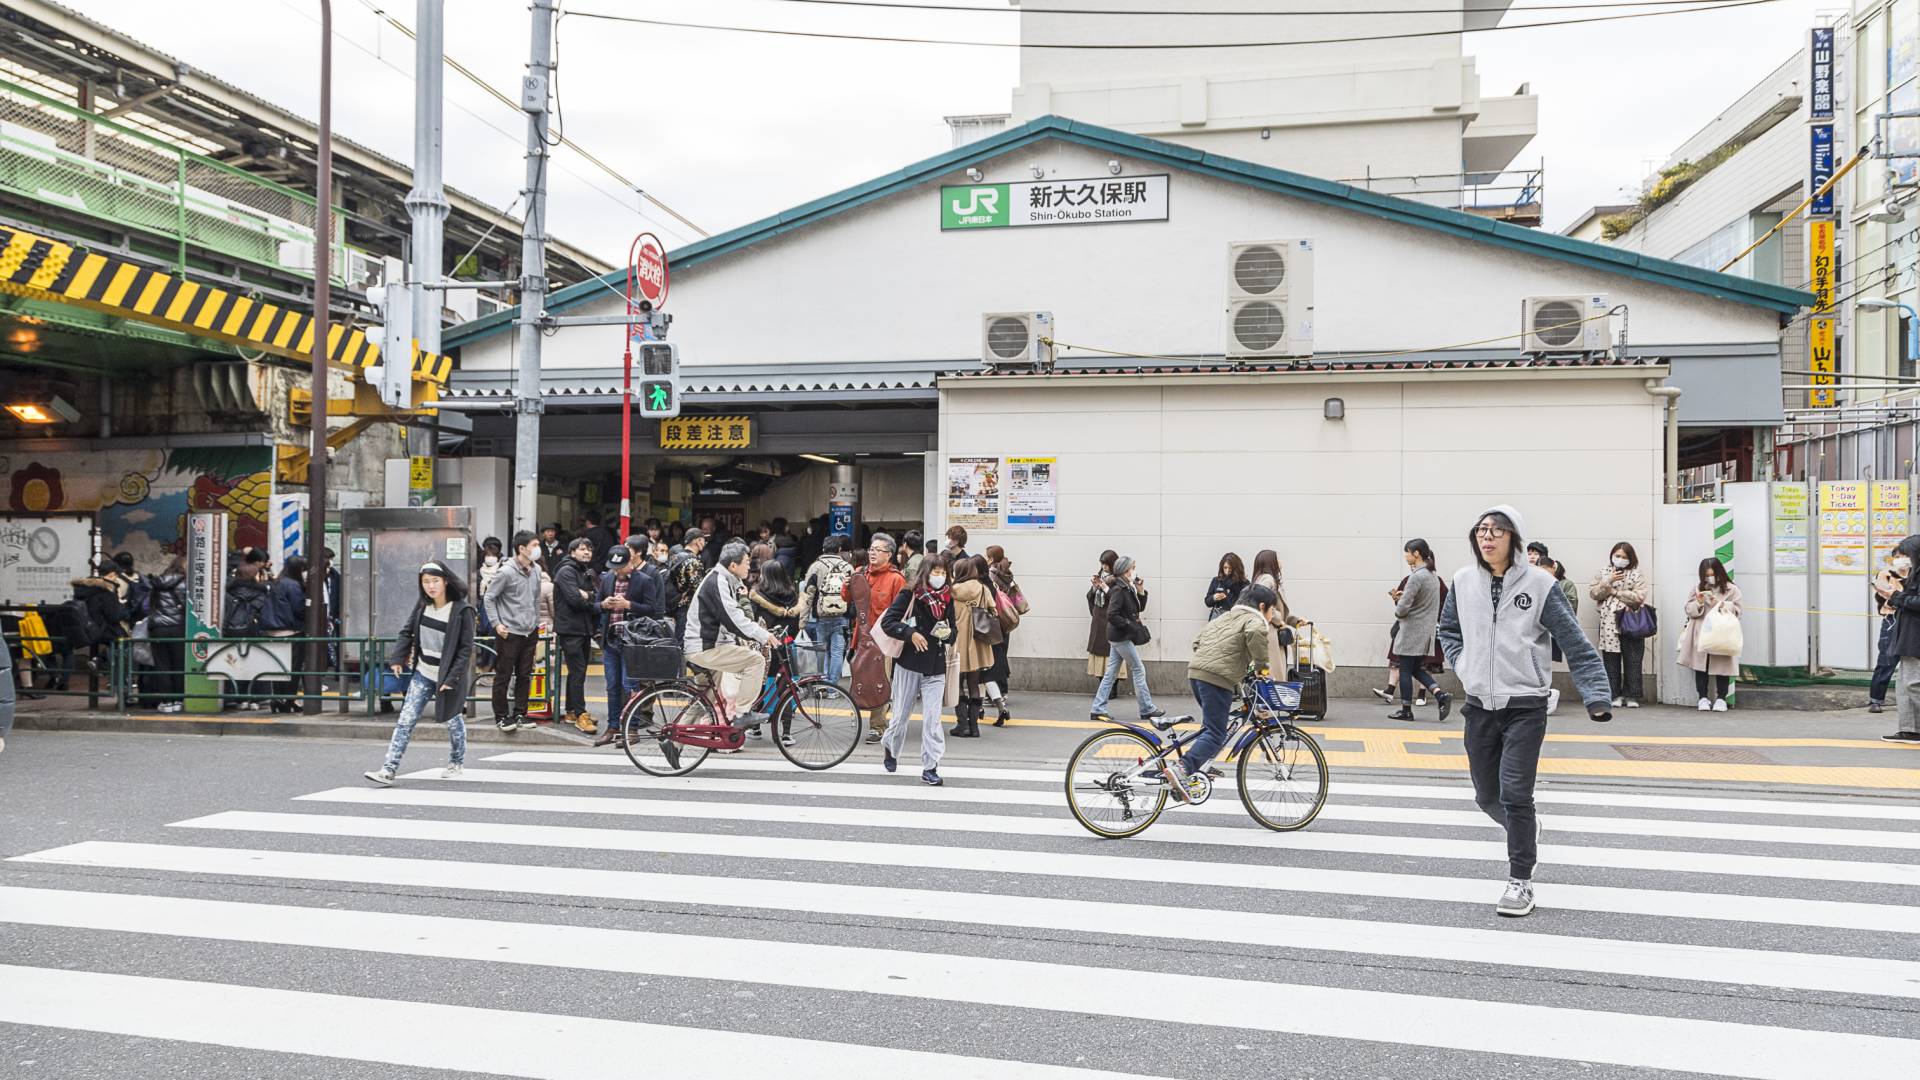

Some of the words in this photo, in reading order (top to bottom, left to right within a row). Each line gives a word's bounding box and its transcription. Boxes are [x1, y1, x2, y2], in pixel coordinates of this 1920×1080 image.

[1815, 50, 1830, 110] 山野楽器
[952, 188, 999, 216] JR
[1029, 181, 1147, 208] 新大久保駅
[1095, 208, 1132, 218] Station
[666, 424, 744, 441] 段差注意
[195, 536, 206, 612] 路上喫煙禁止
